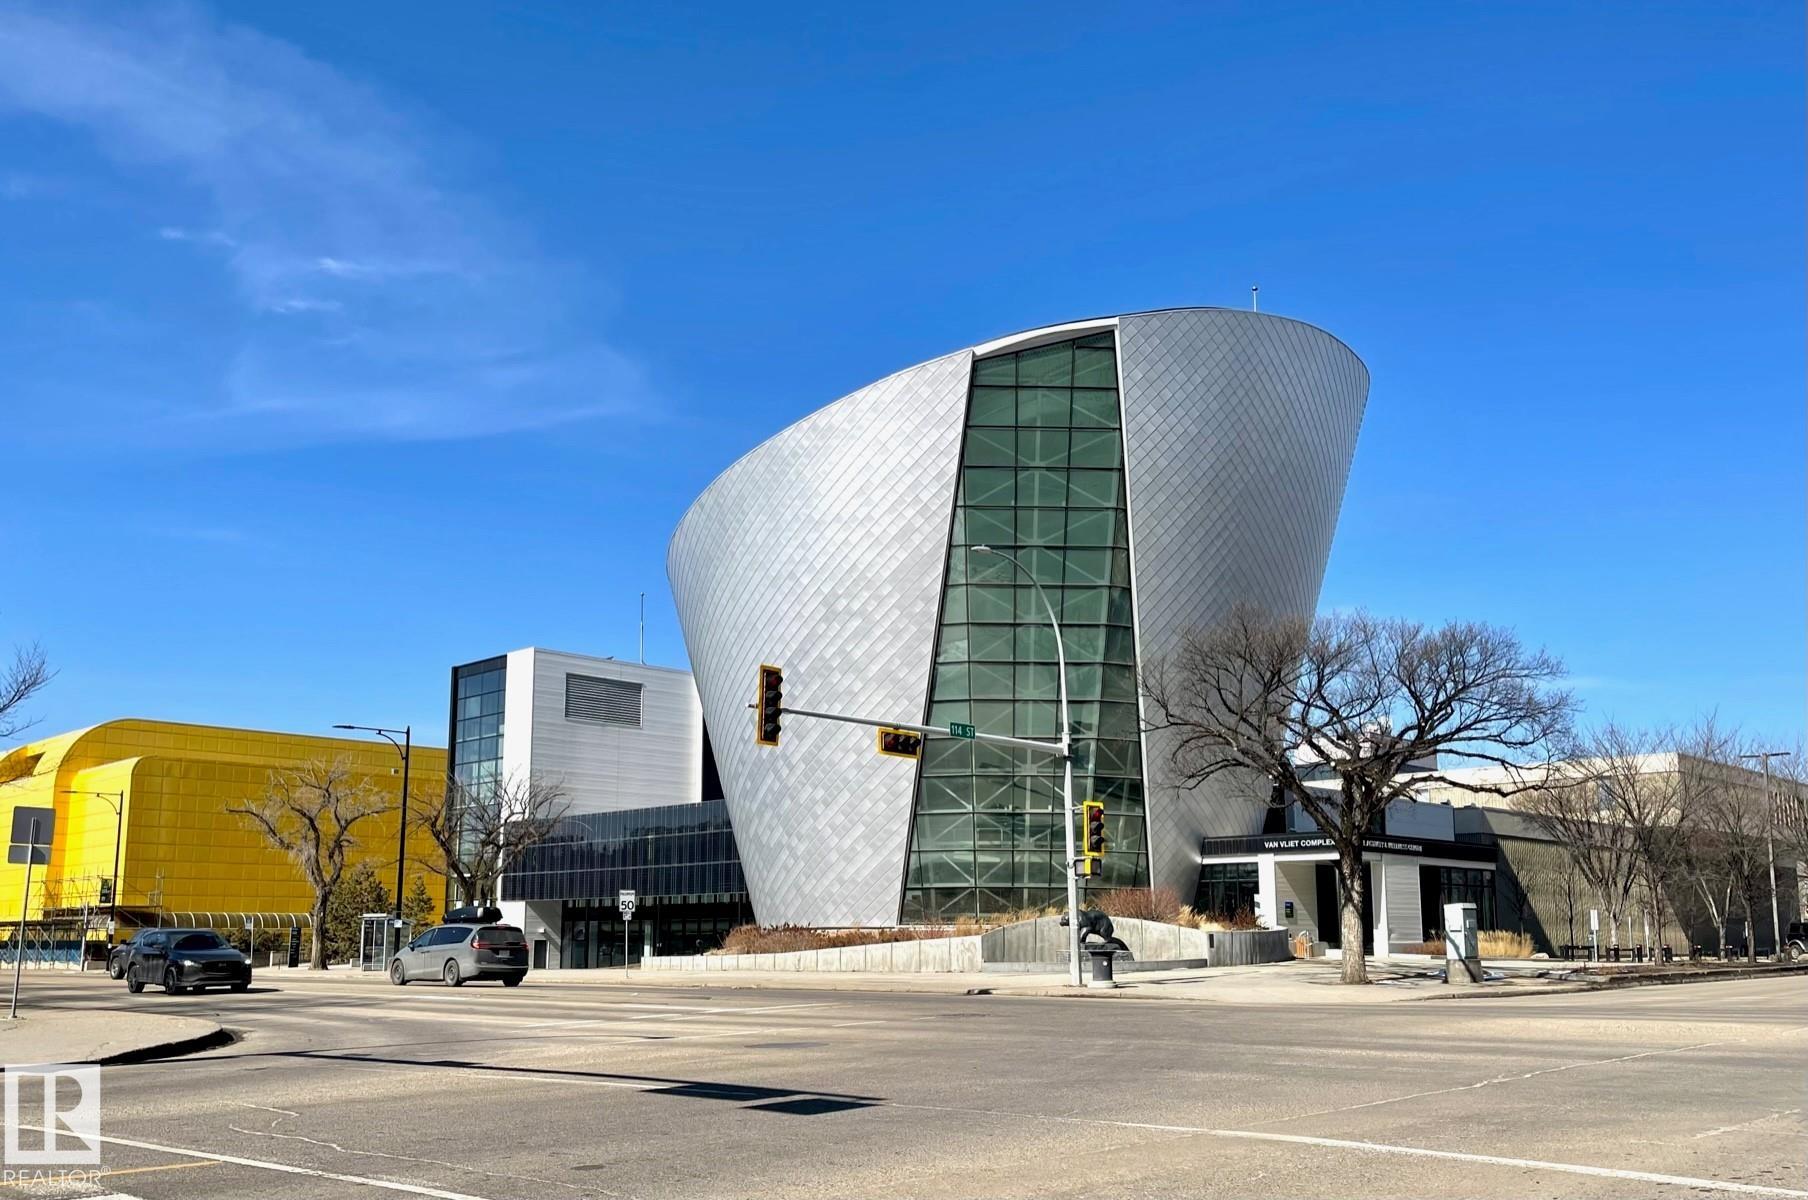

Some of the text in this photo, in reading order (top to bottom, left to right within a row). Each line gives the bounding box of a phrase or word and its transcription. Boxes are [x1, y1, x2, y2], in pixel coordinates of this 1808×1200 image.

[951, 724, 974, 736] 114 ST
[1264, 838, 1336, 849] VAN VLIET COMPLEX
[621, 900, 634, 910] 50
